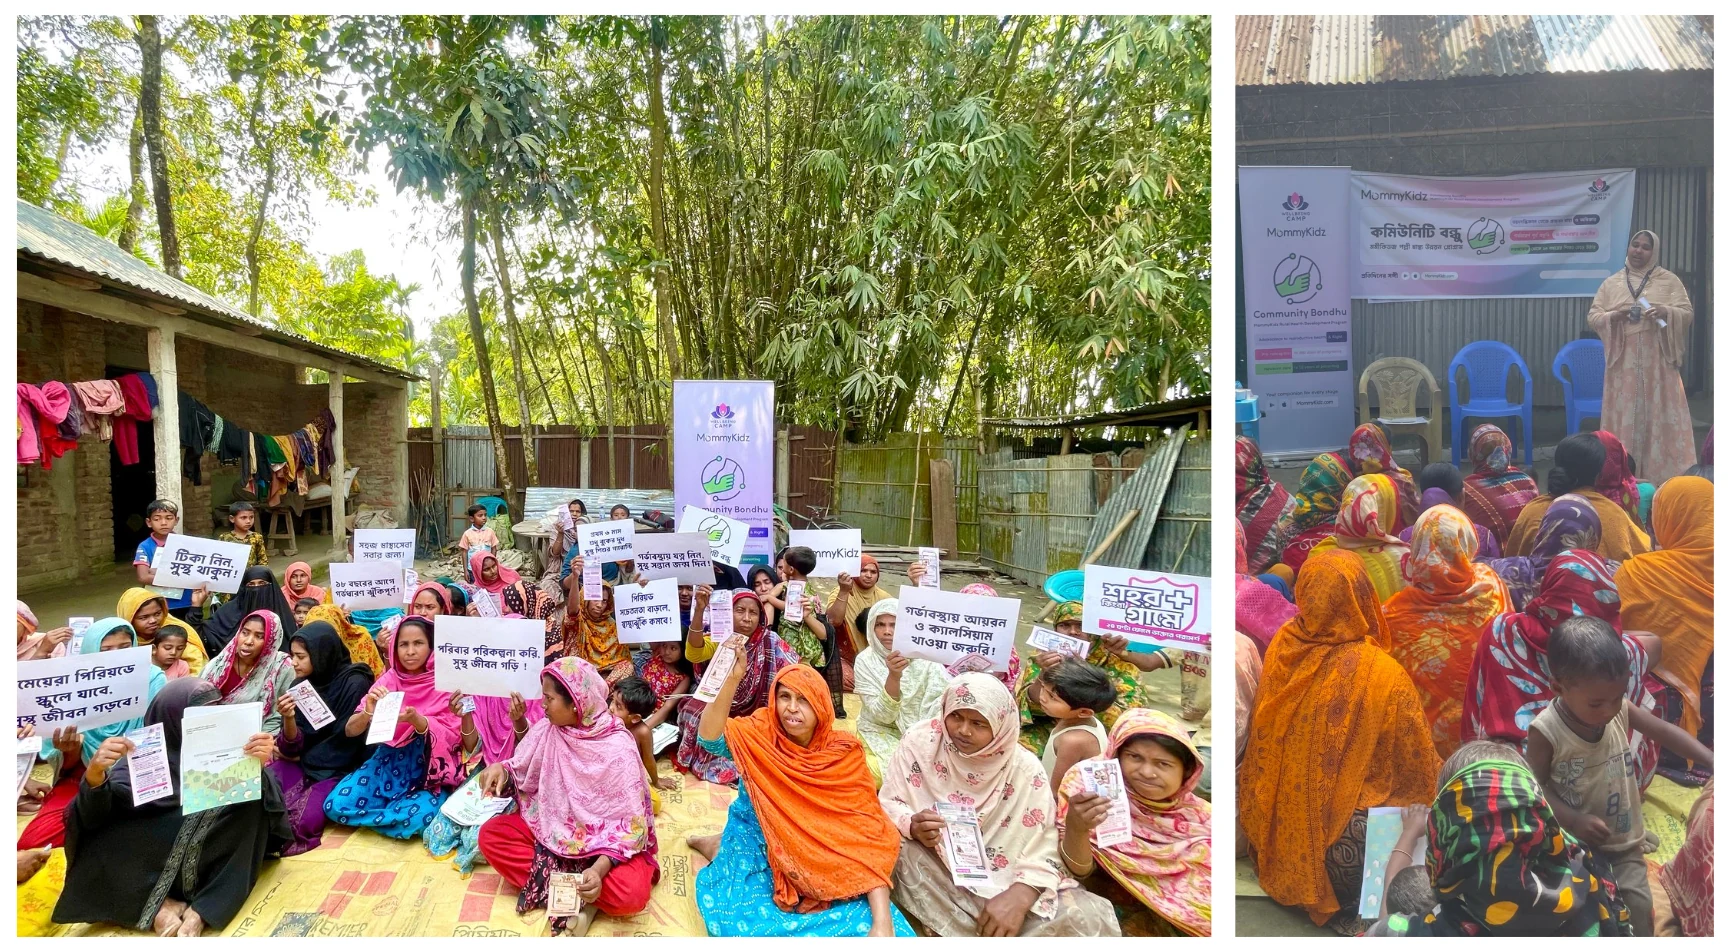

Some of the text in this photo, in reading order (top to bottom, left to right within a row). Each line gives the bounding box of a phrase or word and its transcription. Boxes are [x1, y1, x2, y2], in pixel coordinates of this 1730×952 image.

[1361, 189, 1428, 202] MommyKidz
[1267, 227, 1326, 238] MommyKidz
[1370, 223, 1463, 243] কমিউনিটি বন্ধু
[1253, 308, 1347, 319] Community Bondhu
[696, 433, 750, 443] MommyKidz
[734, 505, 769, 513] Bondhu
[358, 542, 378, 550] সহজ
[175, 548, 206, 564] টিকা
[363, 552, 382, 560] সবার
[813, 548, 860, 560] mmyKidz
[170, 562, 193, 577] সুস্থ
[637, 562, 649, 571] সুস্থ
[348, 580, 373, 588] বছরের
[375, 578, 395, 586] আগে
[631, 592, 654, 603] পিরিয়ড
[1102, 582, 1164, 609] শহর
[619, 606, 646, 616] সচেতনতা
[905, 606, 1007, 628] গর্ভাবস্থায় আয়রন
[1125, 606, 1184, 630] গ্রামে
[915, 623, 993, 642] ও ক্যালসিয়াম
[911, 635, 948, 650] খাওয়া
[438, 643, 469, 655] পরিবার
[472, 645, 516, 658] পরিকল্পনা
[452, 658, 468, 671] সুস্থ
[471, 656, 498, 670] জীবন
[17, 664, 135, 690] মেয়েরা পিরিয়ডে
[36, 692, 72, 708] স্কুলে
[42, 707, 87, 722] জীবন
